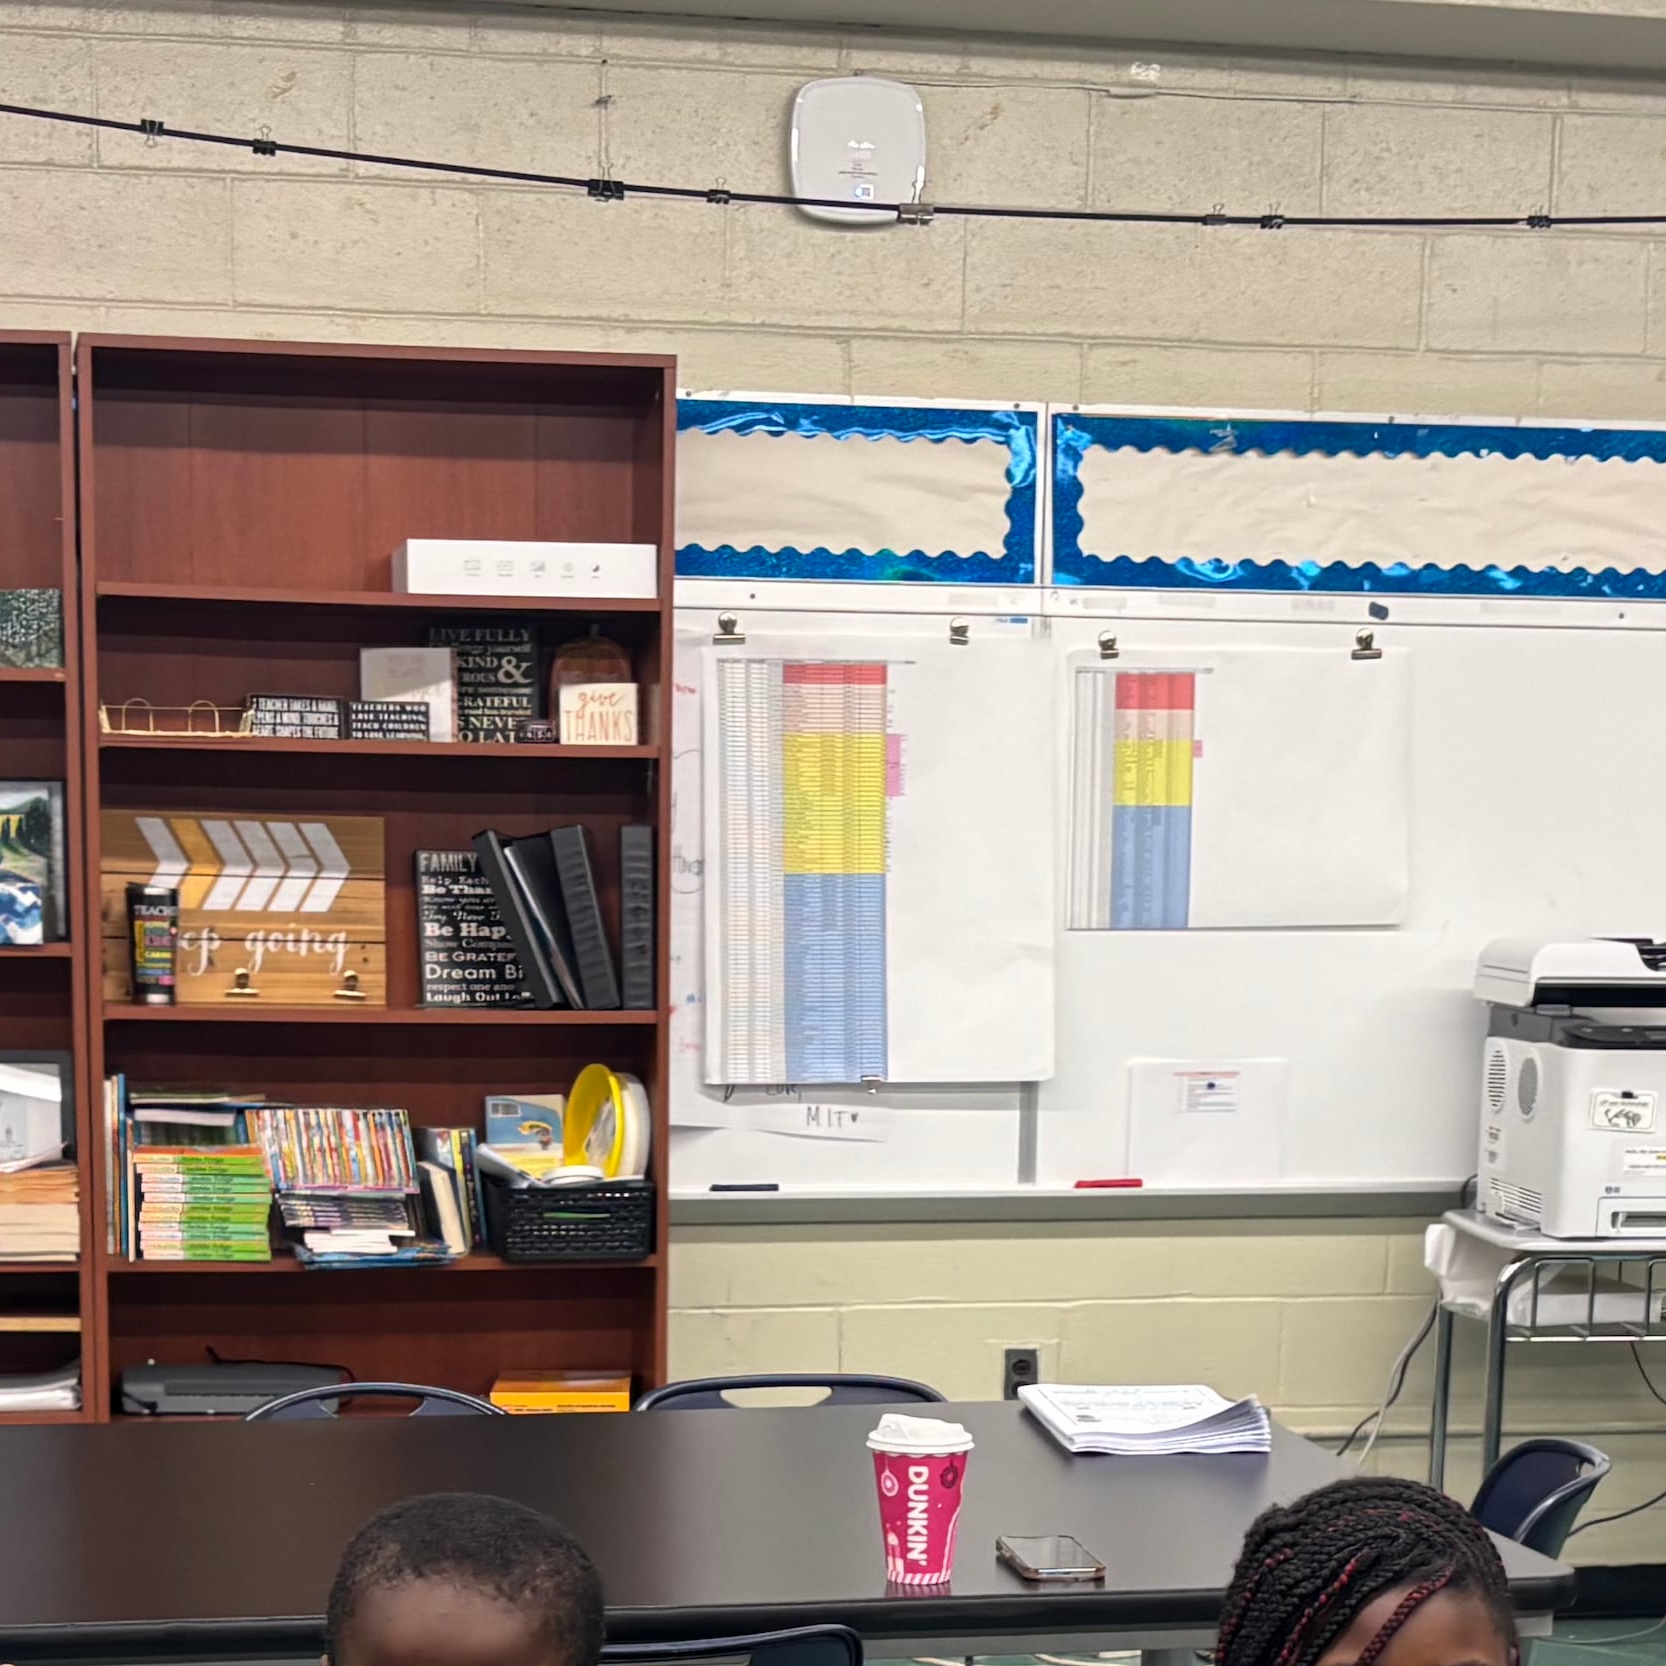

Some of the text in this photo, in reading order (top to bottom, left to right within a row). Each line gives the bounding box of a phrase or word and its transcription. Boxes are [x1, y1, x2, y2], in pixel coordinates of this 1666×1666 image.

[475, 629, 532, 641] FULLY
[497, 656, 533, 684] &
[459, 696, 531, 708] RATEFUL
[578, 690, 622, 709] give
[469, 717, 517, 729] NEVE
[564, 710, 633, 742] THANKS
[479, 731, 516, 743] LAT
[420, 852, 477, 872] FAMILY
[424, 922, 508, 940] Be Hap
[244, 922, 350, 977] going
[425, 952, 517, 962] BE GRATEF
[425, 964, 497, 979] Dream
[426, 992, 470, 1003] Laugh
[906, 1465, 930, 1567] DUNKIN'
